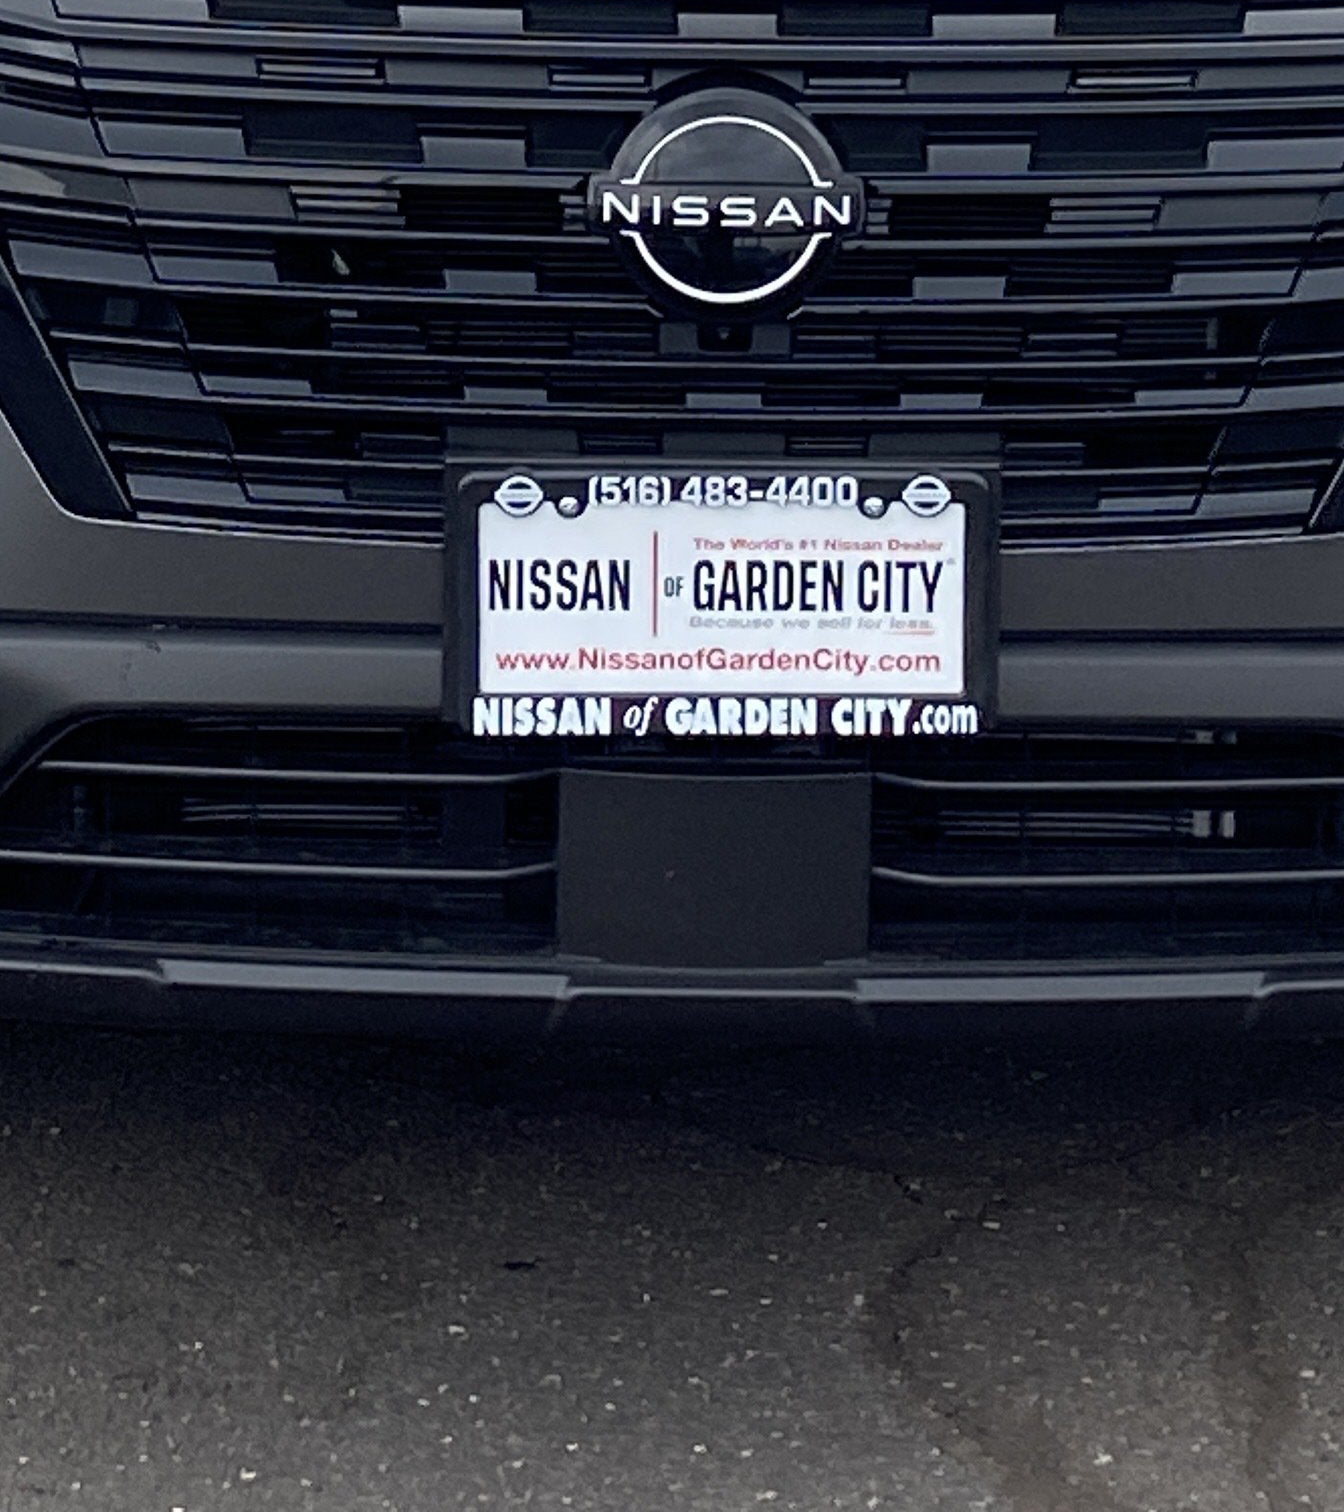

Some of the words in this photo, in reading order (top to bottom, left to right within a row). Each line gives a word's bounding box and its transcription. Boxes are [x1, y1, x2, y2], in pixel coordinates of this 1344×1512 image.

[602, 191, 852, 228] NISSAN
[588, 475, 671, 507] (516)
[679, 475, 859, 508] 483-4400
[693, 537, 725, 551] The
[730, 538, 794, 551] World's
[799, 539, 818, 551] #1
[823, 538, 883, 551] Nissan
[887, 538, 944, 552] Dealer
[488, 559, 631, 612] NISSAN
[663, 576, 684, 598] OF
[693, 559, 844, 613] GARDEN
[857, 560, 944, 613] CITY
[689, 615, 775, 629] Because
[781, 619, 810, 630] we
[856, 617, 883, 630] for
[495, 647, 941, 676] www.NissanofGardenCity.com
[472, 696, 612, 736] NISSAN
[623, 695, 659, 736] of
[664, 697, 818, 736] GARDEN
[830, 697, 978, 736] CITY.com
